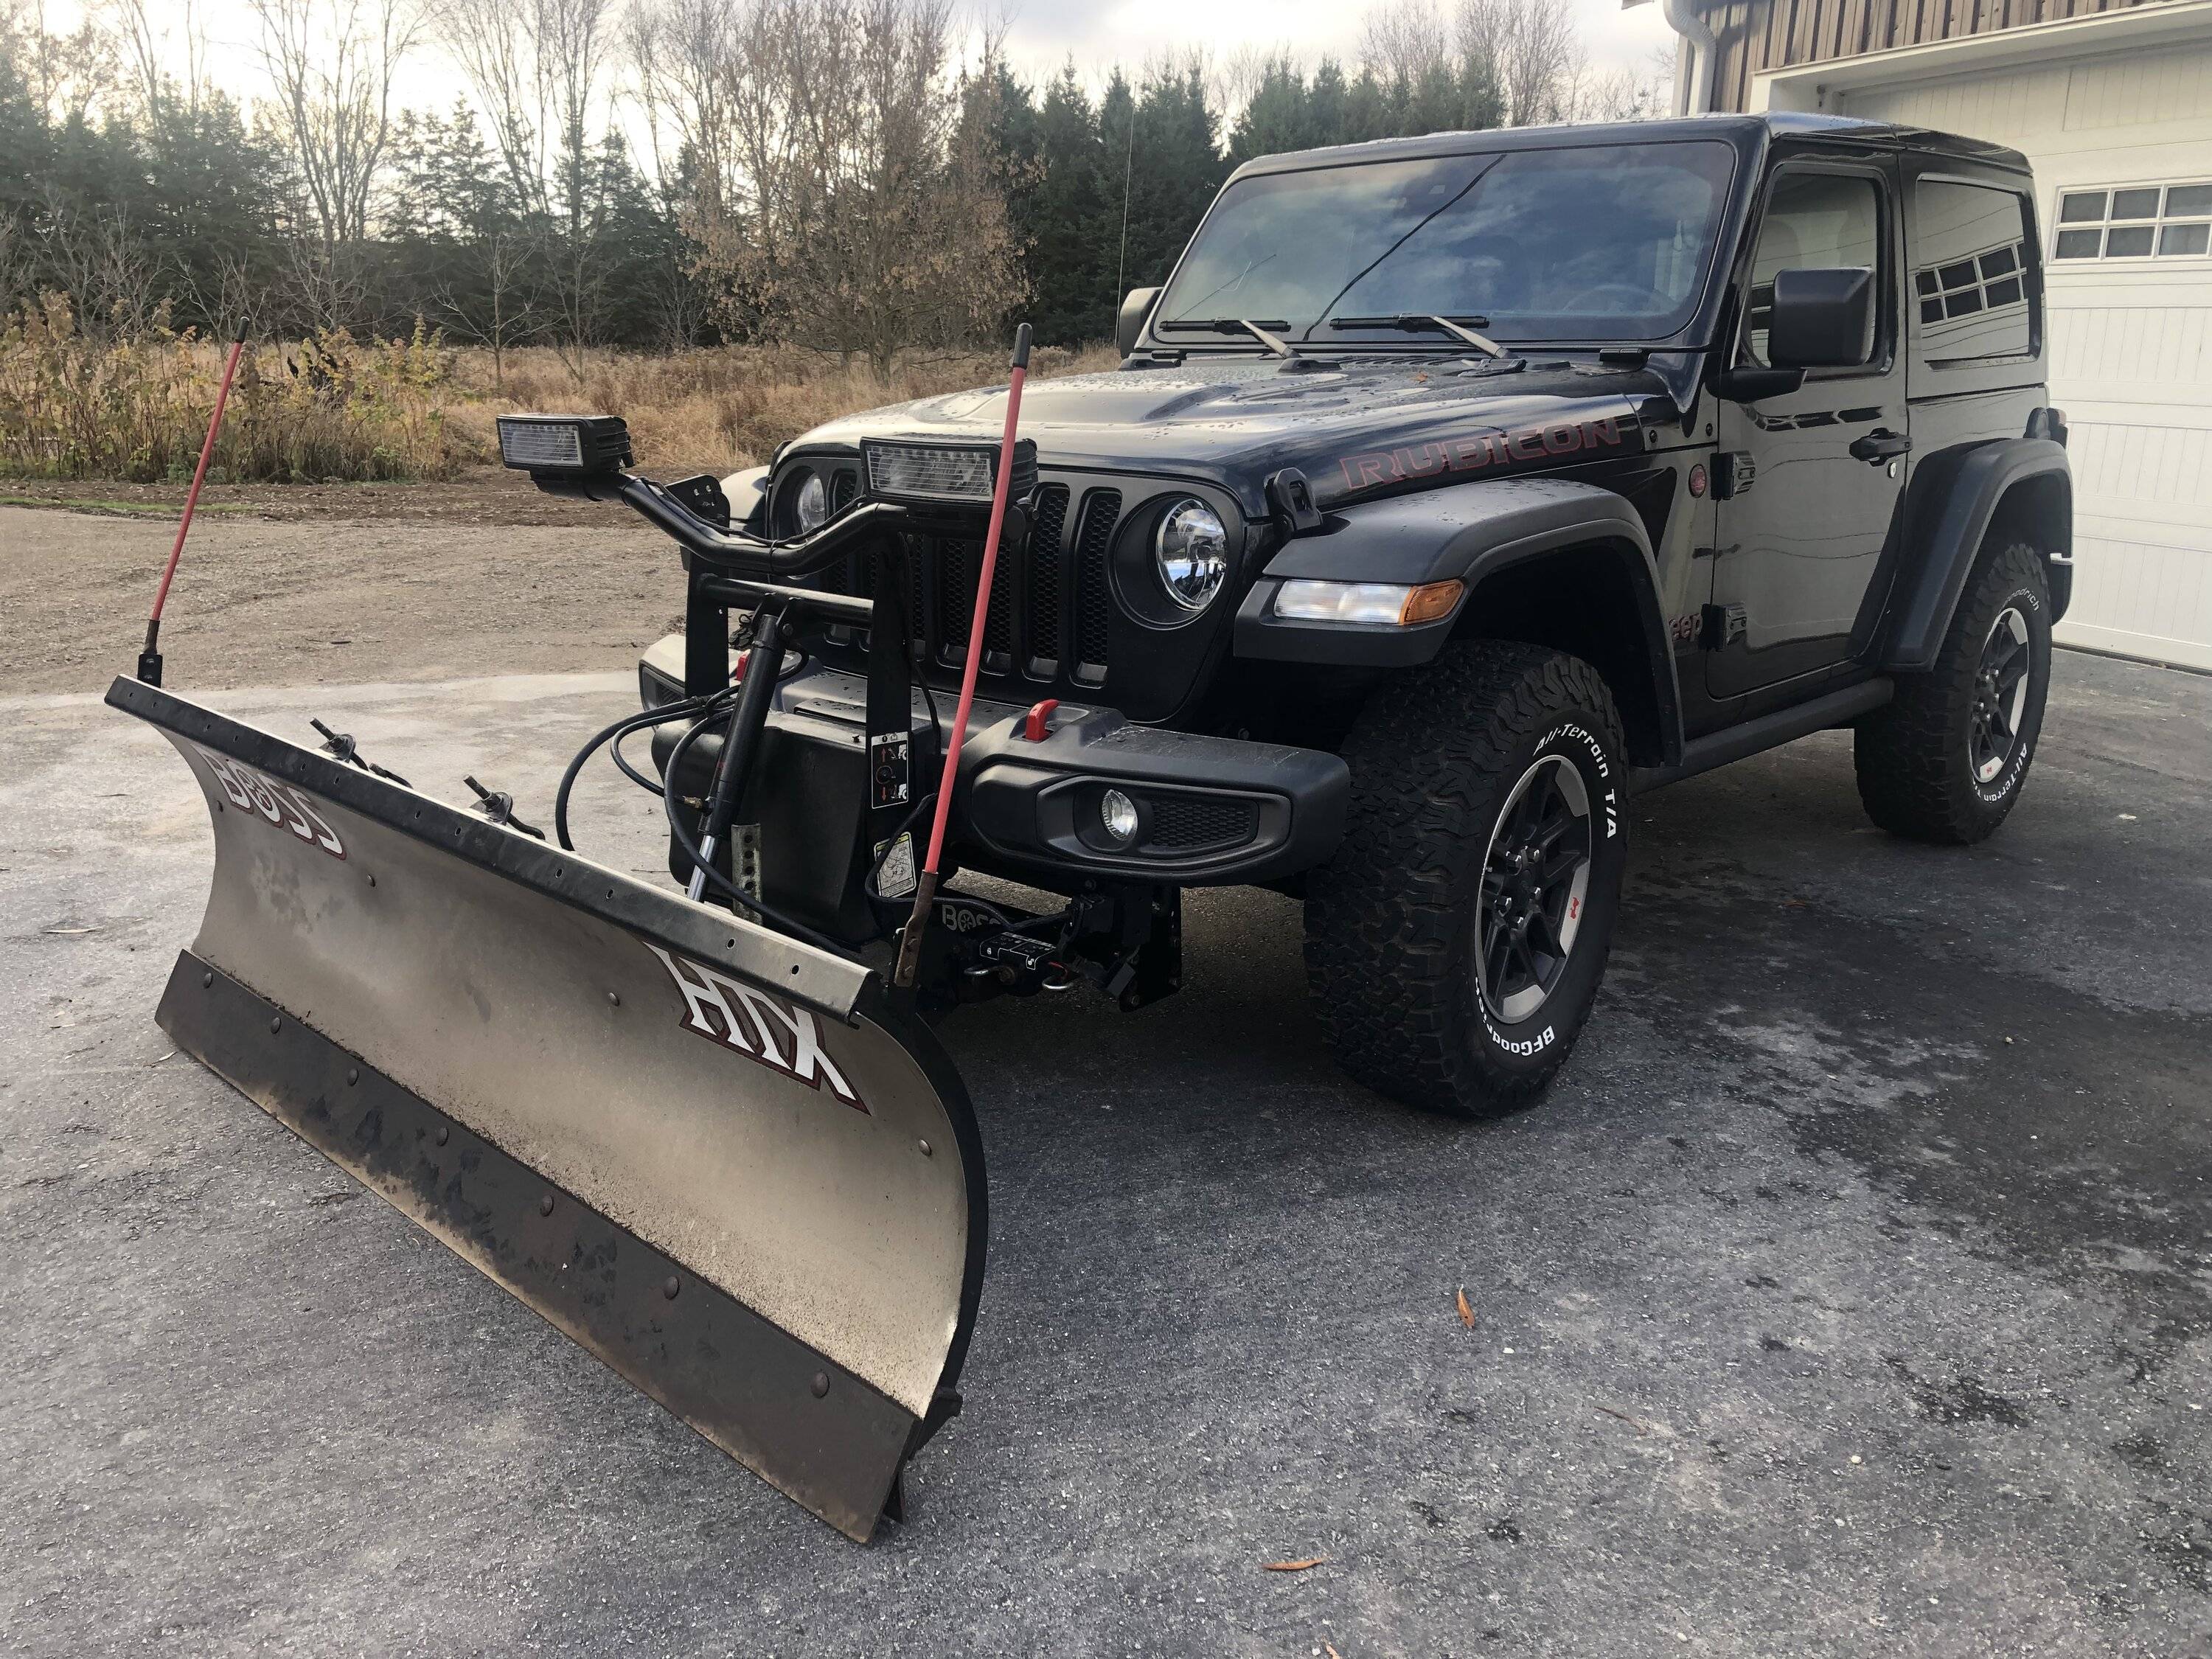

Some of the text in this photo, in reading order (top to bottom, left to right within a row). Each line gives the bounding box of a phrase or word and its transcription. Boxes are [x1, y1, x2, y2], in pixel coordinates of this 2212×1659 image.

[1340, 417, 1622, 490] RUBICON
[1669, 613, 1703, 642] eep
[190, 744, 344, 857] BOSS
[1533, 723, 1618, 839] All-Terrain T/A
[1983, 742, 2028, 802] All-Terrain
[642, 941, 863, 1106] HTX
